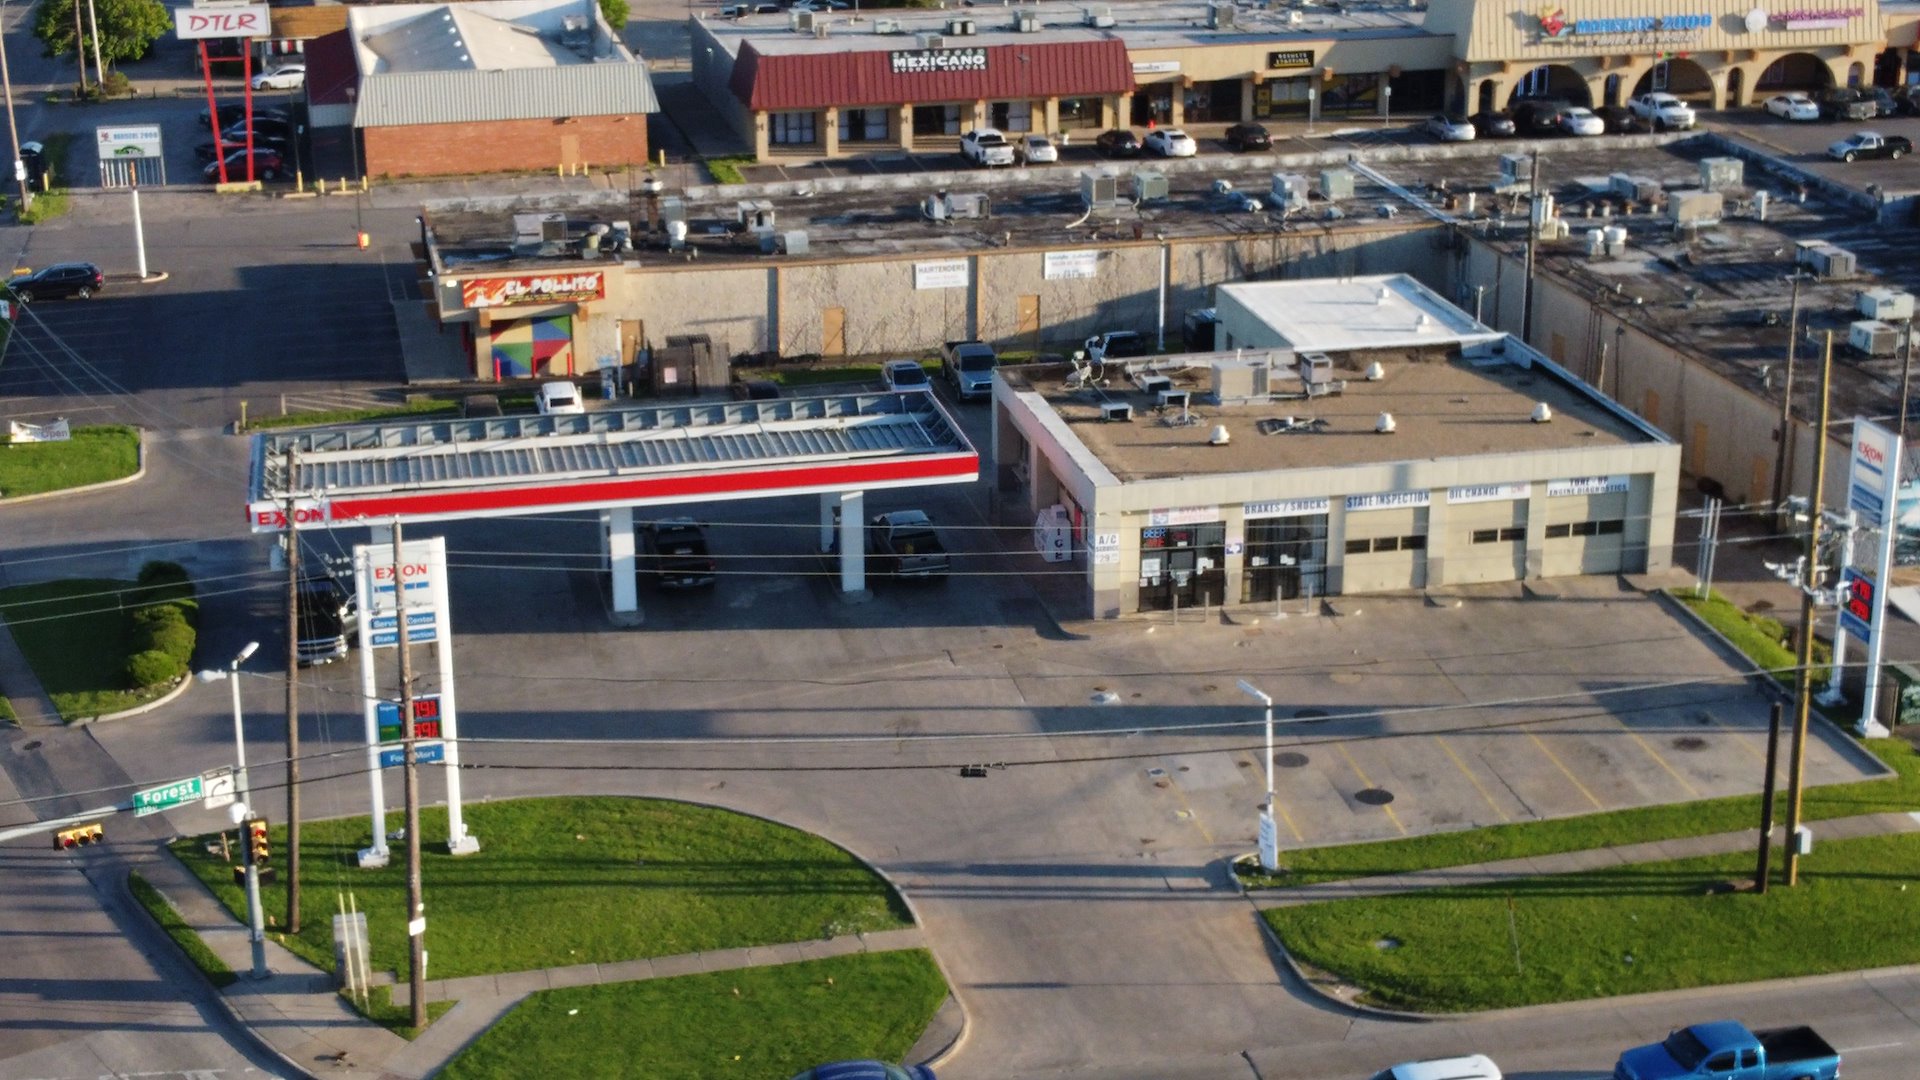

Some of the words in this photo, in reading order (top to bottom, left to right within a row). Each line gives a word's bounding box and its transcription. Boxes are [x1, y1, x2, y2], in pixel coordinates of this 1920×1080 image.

[189, 14, 258, 31] DTLR
[1661, 14, 1712, 30] 2000
[893, 55, 986, 67] MEXICANO
[505, 281, 525, 294] EL
[531, 276, 598, 293] POLLITO
[1857, 442, 1883, 464] EXXON
[1347, 495, 1374, 508] STATE
[1376, 491, 1430, 506] INSPECTION
[1449, 488, 1463, 499] OIL
[1465, 486, 1499, 498] CHANGE
[1244, 503, 1281, 515] BRAKES
[1290, 499, 1328, 511] SHOCKS
[1054, 528, 1064, 560] ICE
[1098, 535, 1117, 544] A/C
[375, 564, 427, 581] EXON
[408, 616, 434, 625] Center
[142, 782, 194, 805] Forest
